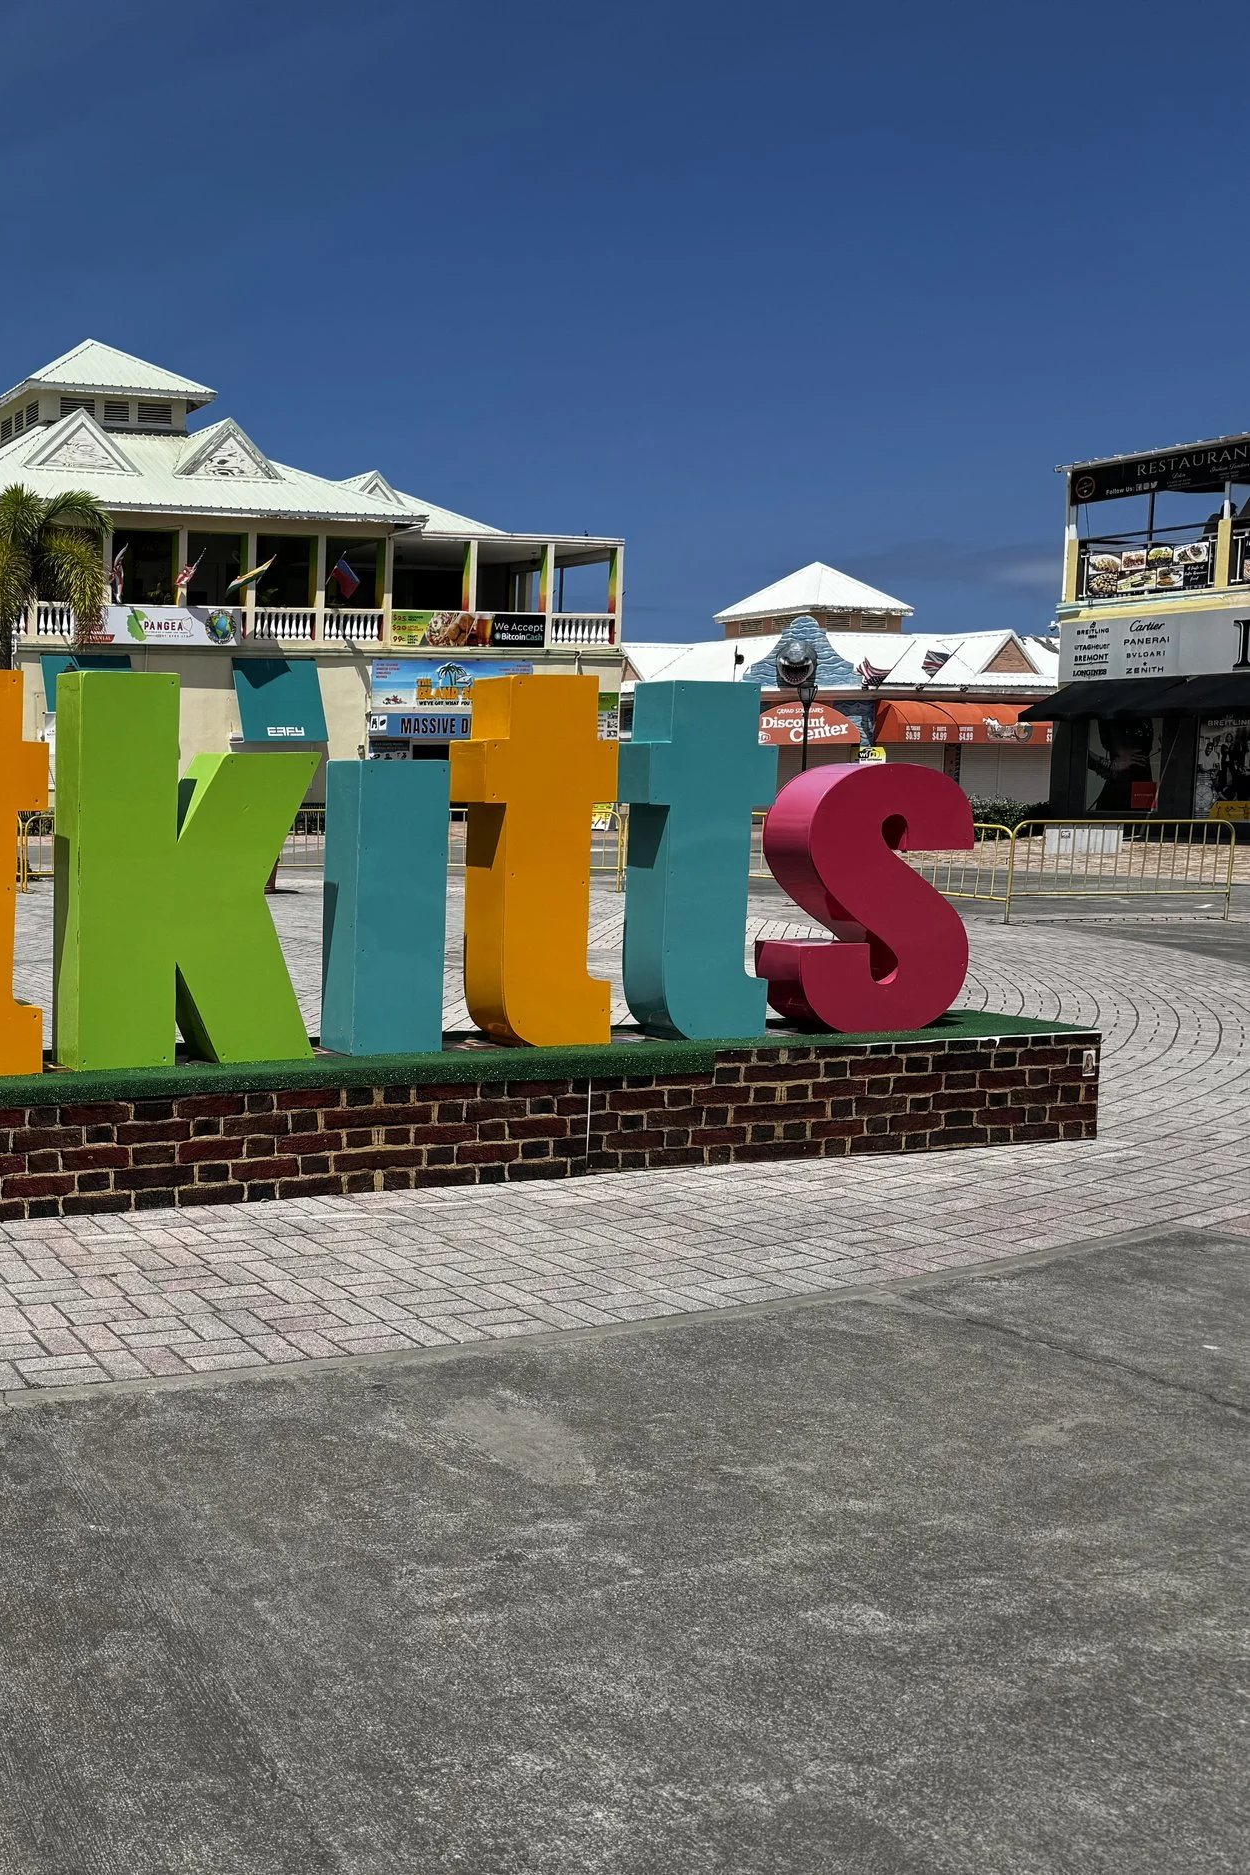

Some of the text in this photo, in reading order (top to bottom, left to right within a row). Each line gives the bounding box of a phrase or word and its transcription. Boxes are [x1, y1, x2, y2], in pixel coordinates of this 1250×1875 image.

[1137, 445, 1250, 476] RESTAURAN
[144, 621, 183, 631] PANGEA
[494, 622, 544, 632] We Accept
[1076, 627, 1109, 635] BREITLING
[1129, 620, 1165, 632] Cartier
[1123, 636, 1170, 646] PANERAI
[1074, 653, 1109, 662] BREMONT
[1126, 651, 1166, 659] BVLGARI
[1072, 668, 1107, 678] LONGINES
[1125, 666, 1164, 675] ZENITH
[417, 686, 459, 699] ISLAND
[400, 717, 456, 734] MASSIVE
[790, 723, 849, 742] Center
